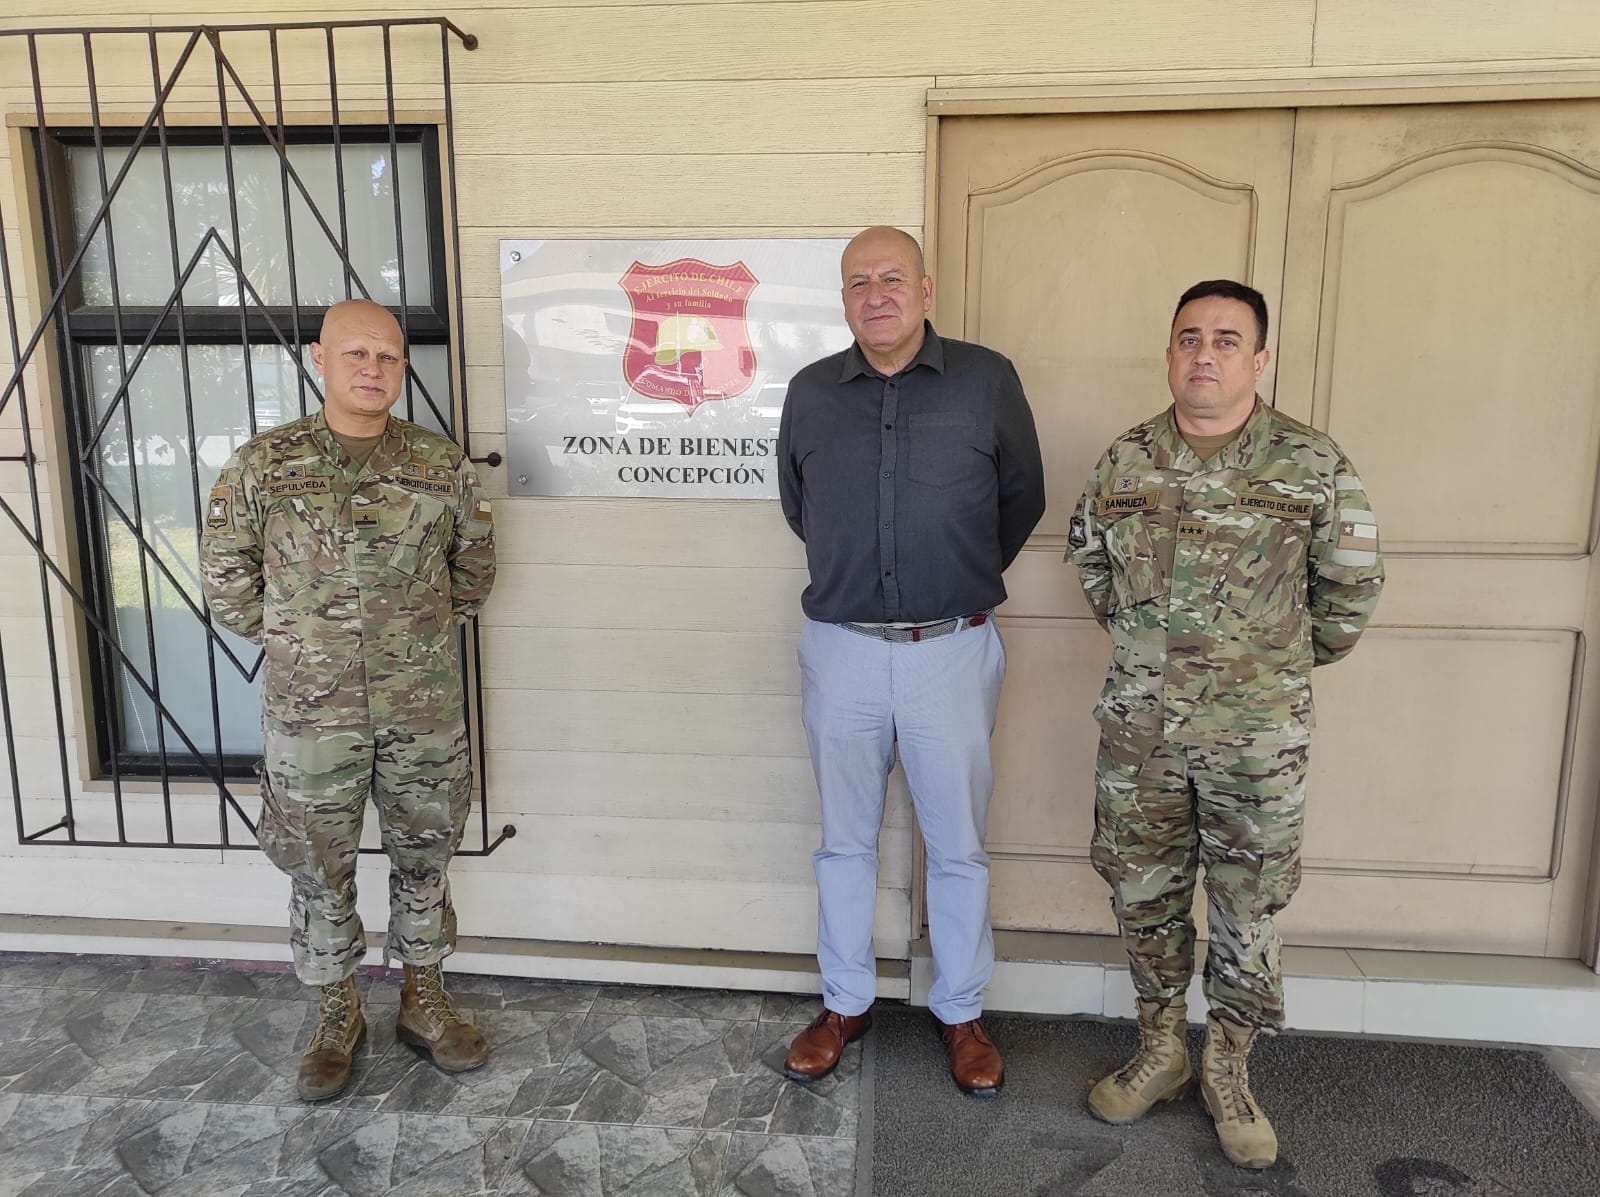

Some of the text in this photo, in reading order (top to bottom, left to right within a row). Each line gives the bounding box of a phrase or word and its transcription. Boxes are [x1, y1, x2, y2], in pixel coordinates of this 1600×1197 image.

[634, 271, 744, 296] EJERCITO DE CHILE
[684, 298, 712, 309] familia
[562, 436, 780, 457] ZONA DE BIENEST
[617, 463, 766, 484] CONCEPCIÓN
[270, 480, 327, 494] SEPULVEDA
[1105, 496, 1148, 510] SANHUEZA
[1240, 497, 1311, 514] EJERCITO DE CHILE
